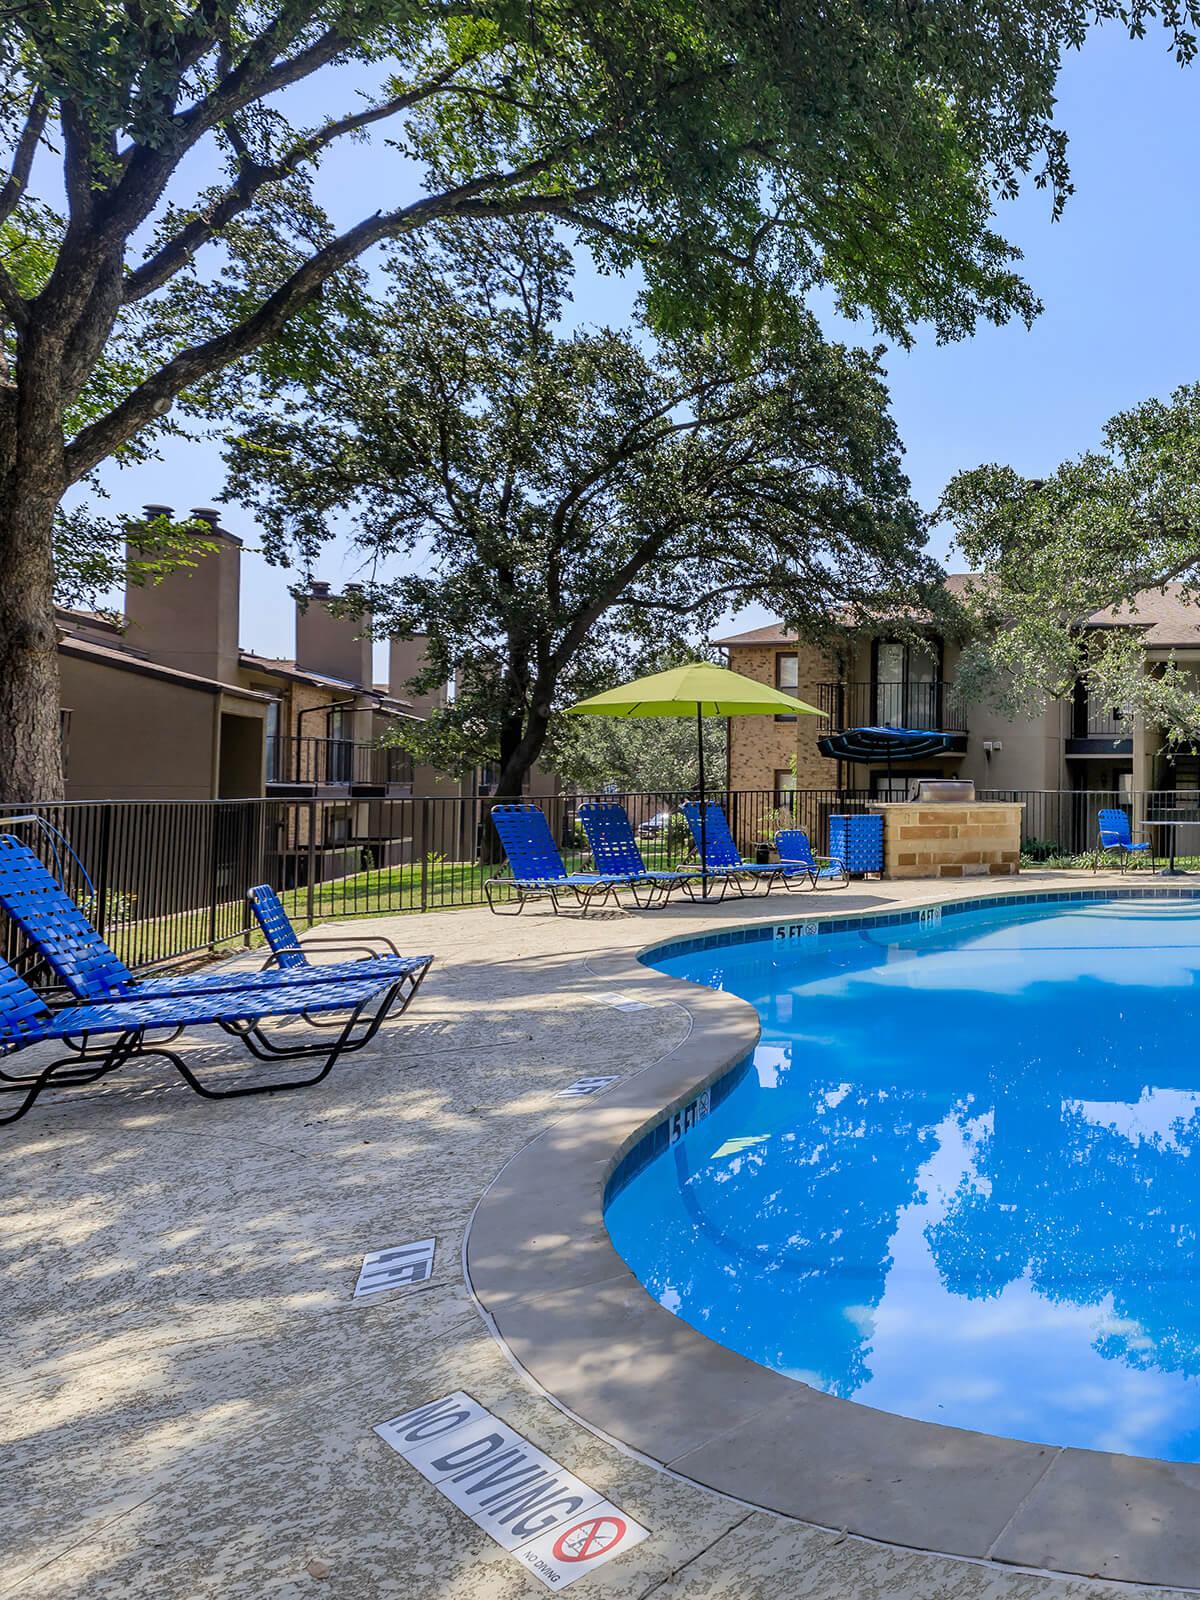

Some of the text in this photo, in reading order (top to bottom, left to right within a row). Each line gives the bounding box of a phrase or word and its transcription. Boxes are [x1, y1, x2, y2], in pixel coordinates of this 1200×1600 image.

[776, 925, 803, 940] 5 FT
[673, 1100, 697, 1145] 5 FT
[360, 1260, 428, 1291] FT
[389, 1398, 584, 1540] NO DIVING
[523, 1551, 561, 1583] NO DIVING
